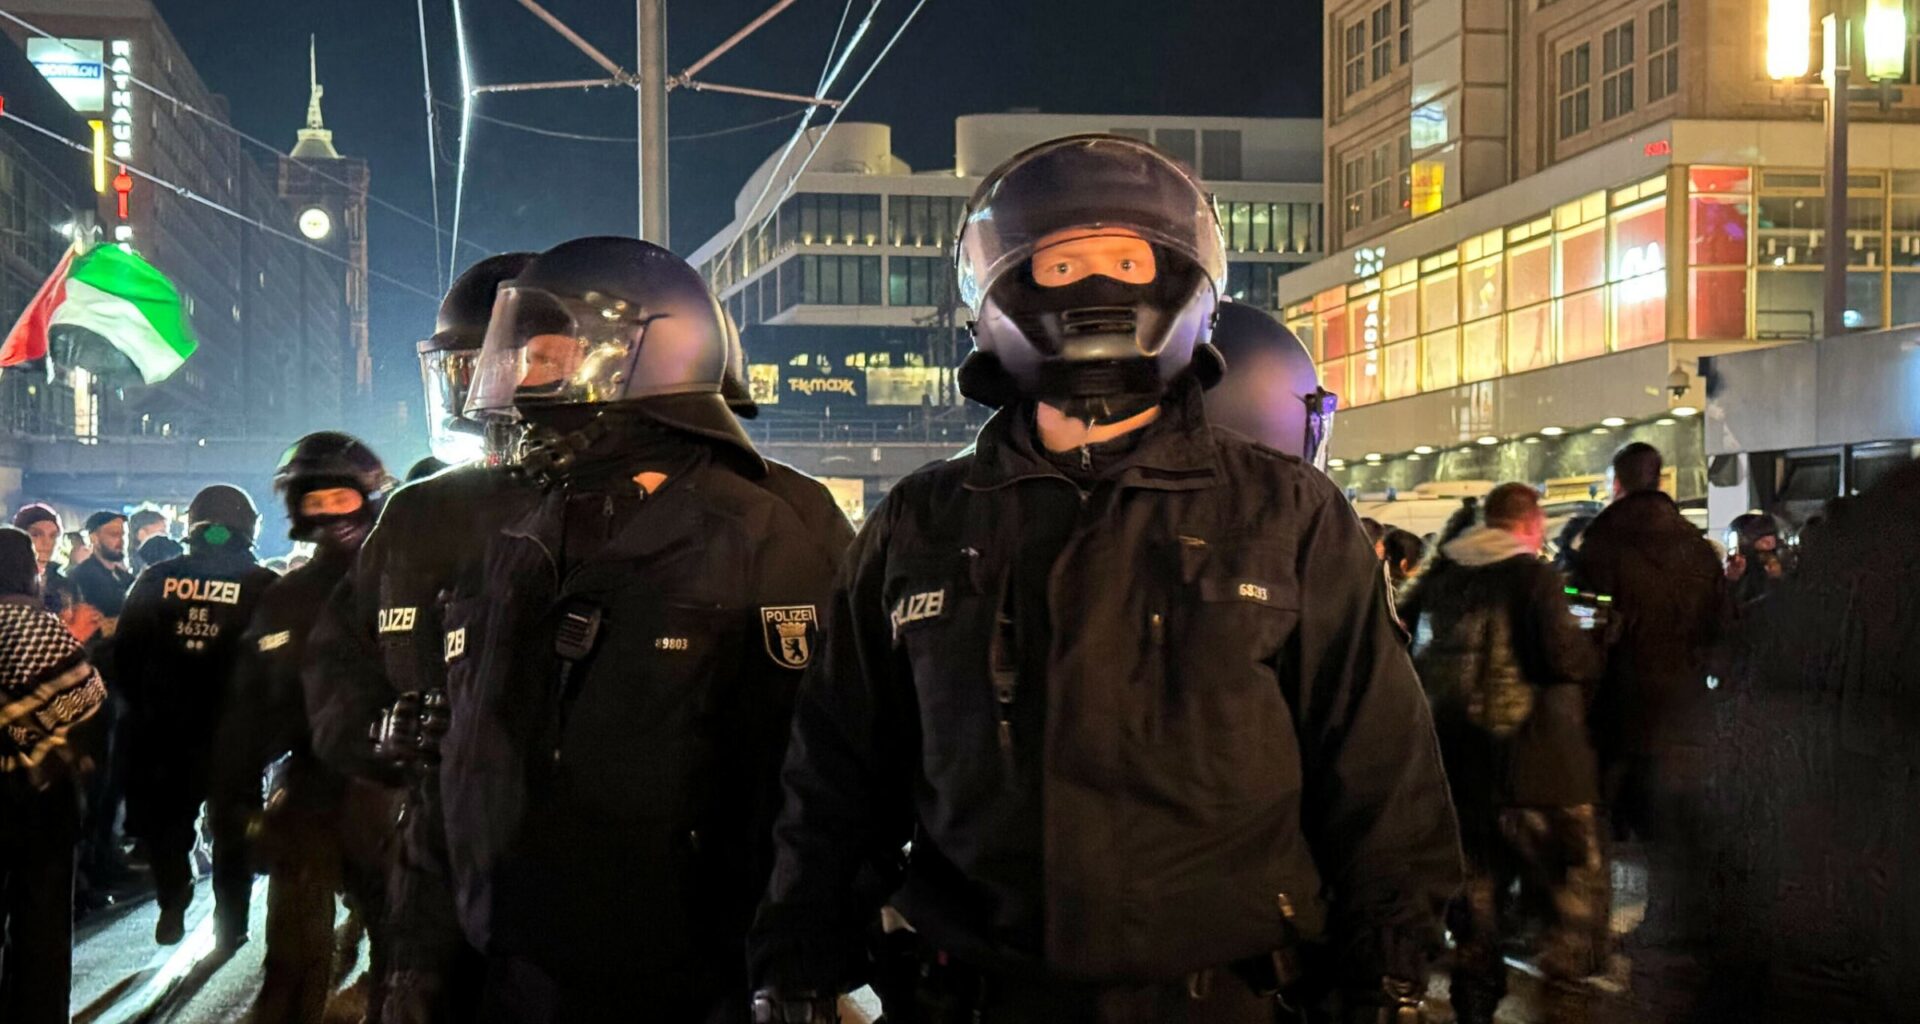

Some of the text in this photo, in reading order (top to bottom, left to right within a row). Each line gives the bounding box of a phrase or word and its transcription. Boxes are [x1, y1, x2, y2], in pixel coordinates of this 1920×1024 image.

[163, 578, 241, 604] POLIZEI
[188, 607, 209, 622] BE
[378, 607, 417, 633] OLIZEI
[766, 609, 813, 623] POLIZEI
